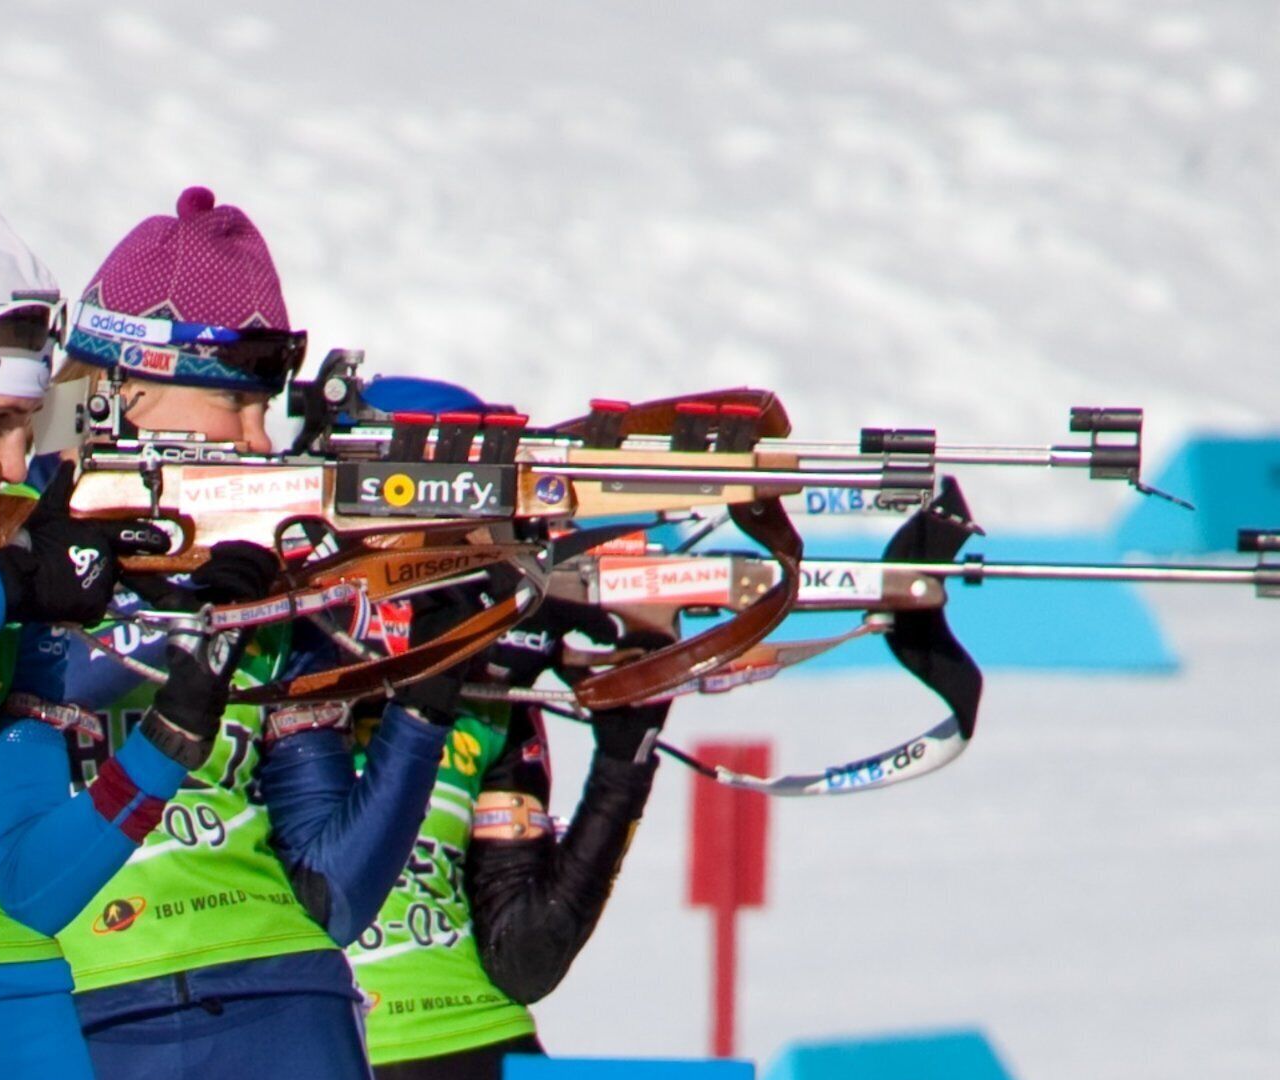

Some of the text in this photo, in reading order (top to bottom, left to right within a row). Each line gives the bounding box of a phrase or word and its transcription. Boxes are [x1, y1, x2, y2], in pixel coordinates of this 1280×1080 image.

[91, 313, 147, 338] adidas
[384, 551, 470, 586] Larsen
[154, 900, 185, 919] IBU
[190, 889, 248, 912] WORLD
